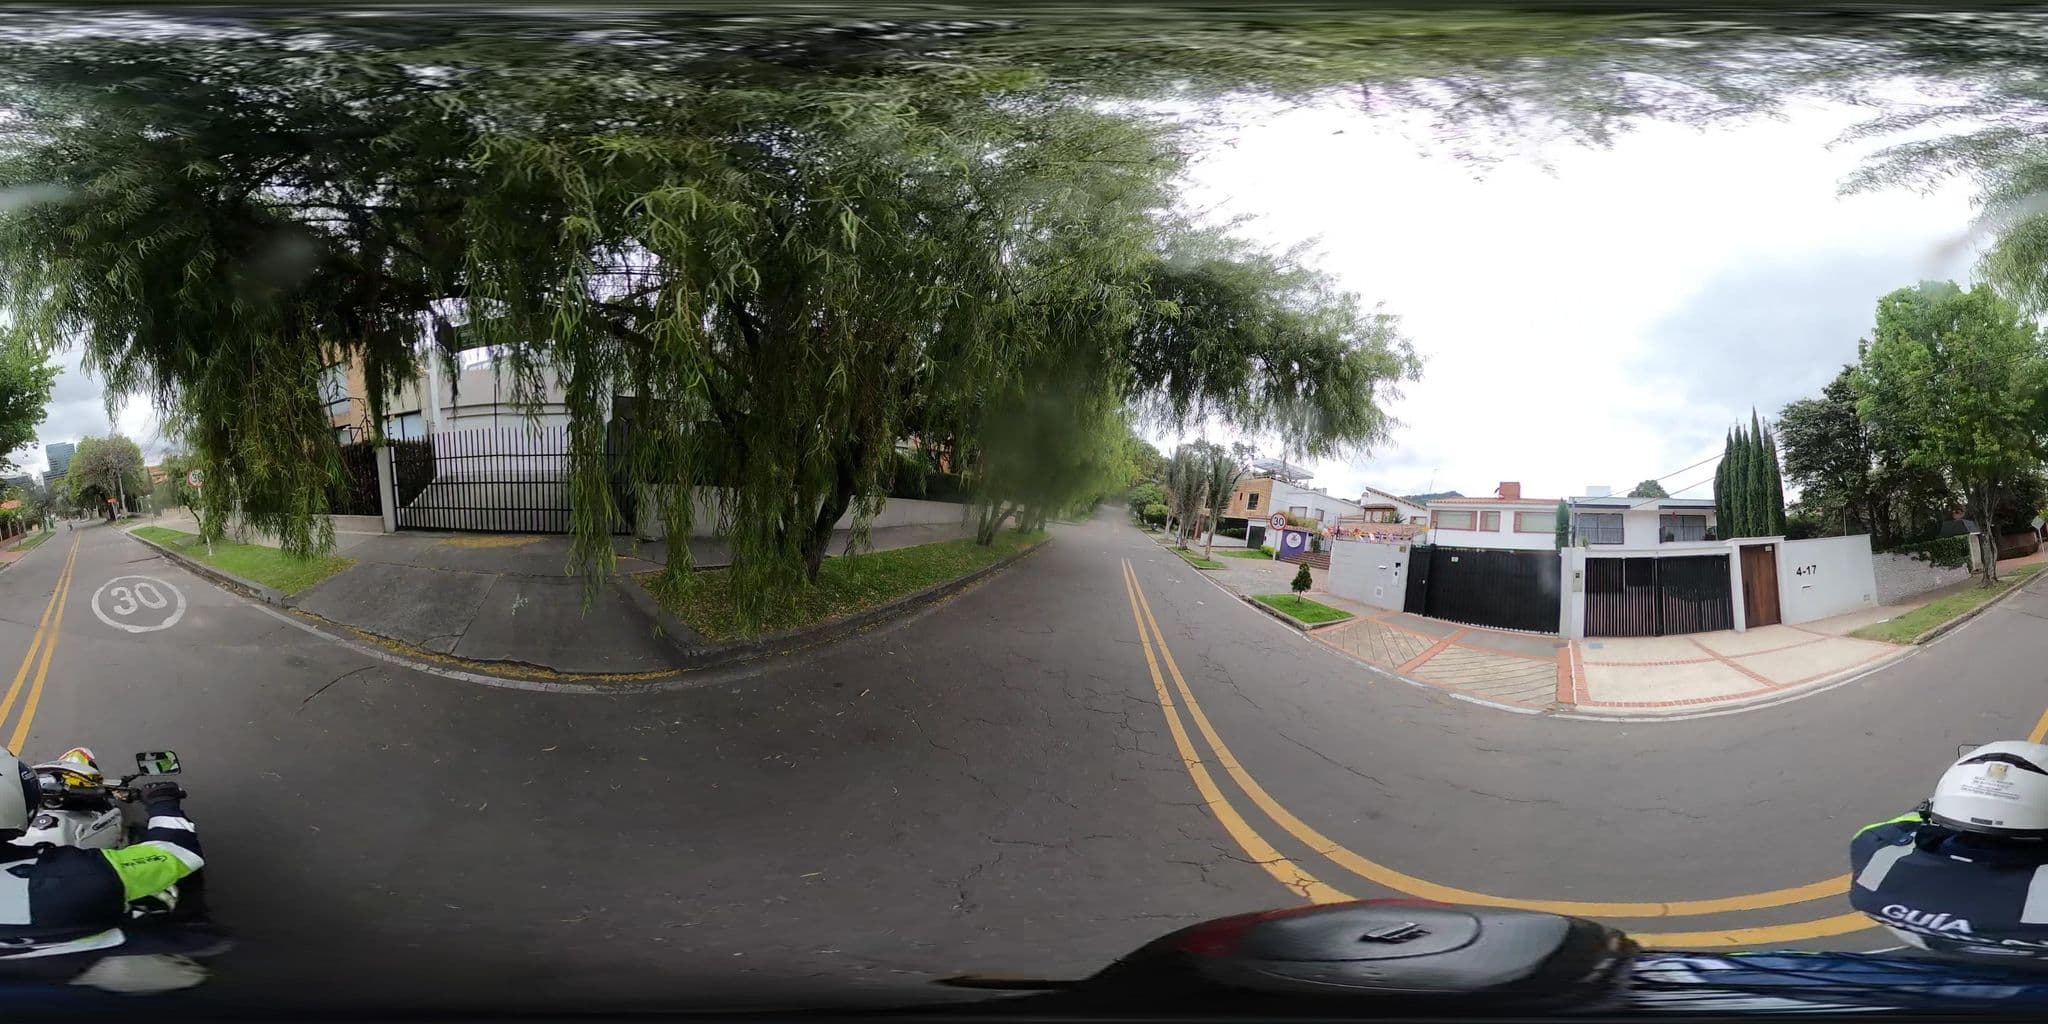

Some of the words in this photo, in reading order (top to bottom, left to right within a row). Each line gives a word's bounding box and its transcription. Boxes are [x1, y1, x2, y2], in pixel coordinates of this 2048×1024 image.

[1273, 516, 1285, 527] 30
[1796, 565, 1817, 576] 4-17
[111, 582, 167, 615] 30
[1881, 904, 1973, 934] GUÍA
